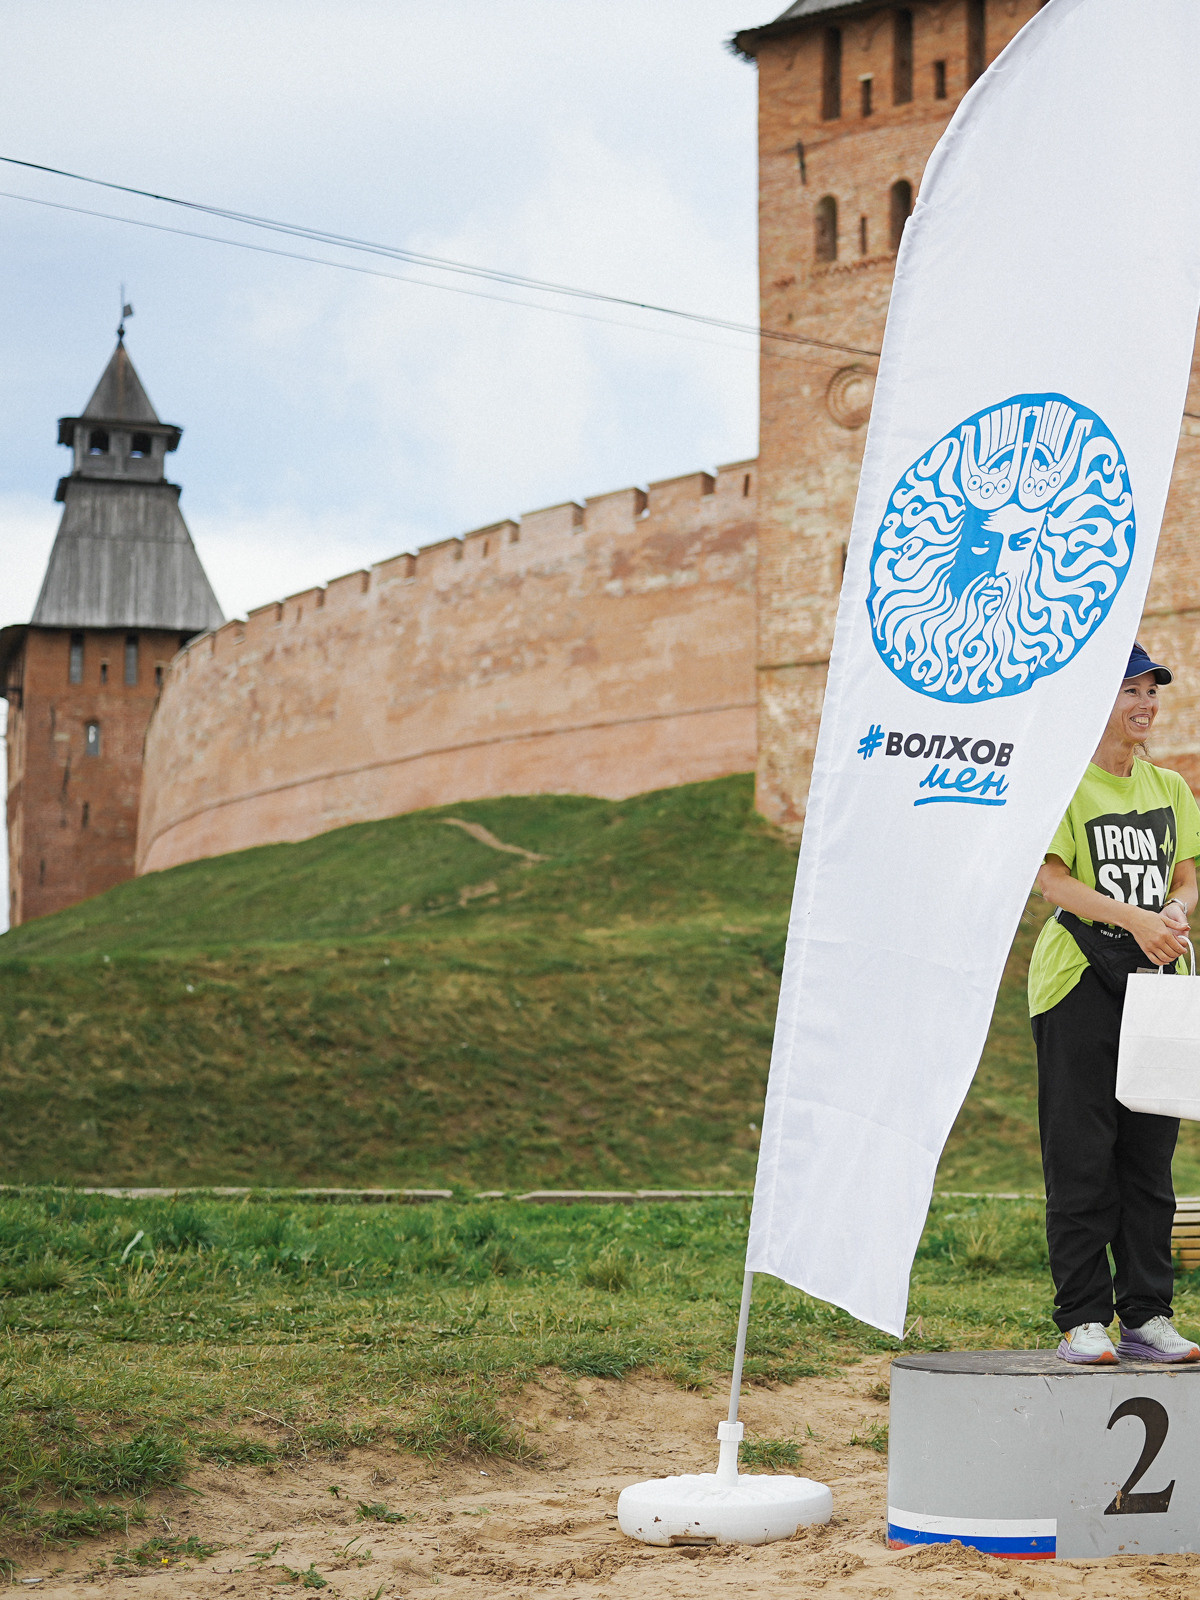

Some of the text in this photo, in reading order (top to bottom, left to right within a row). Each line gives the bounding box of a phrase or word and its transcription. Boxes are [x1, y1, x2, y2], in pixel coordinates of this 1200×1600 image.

[857, 724, 1014, 767] #ВОЛХОВ
[919, 763, 1010, 796] мен
[1093, 824, 1158, 861] IRON
[1098, 863, 1169, 908] STA
[1103, 1396, 1176, 1515] 2
